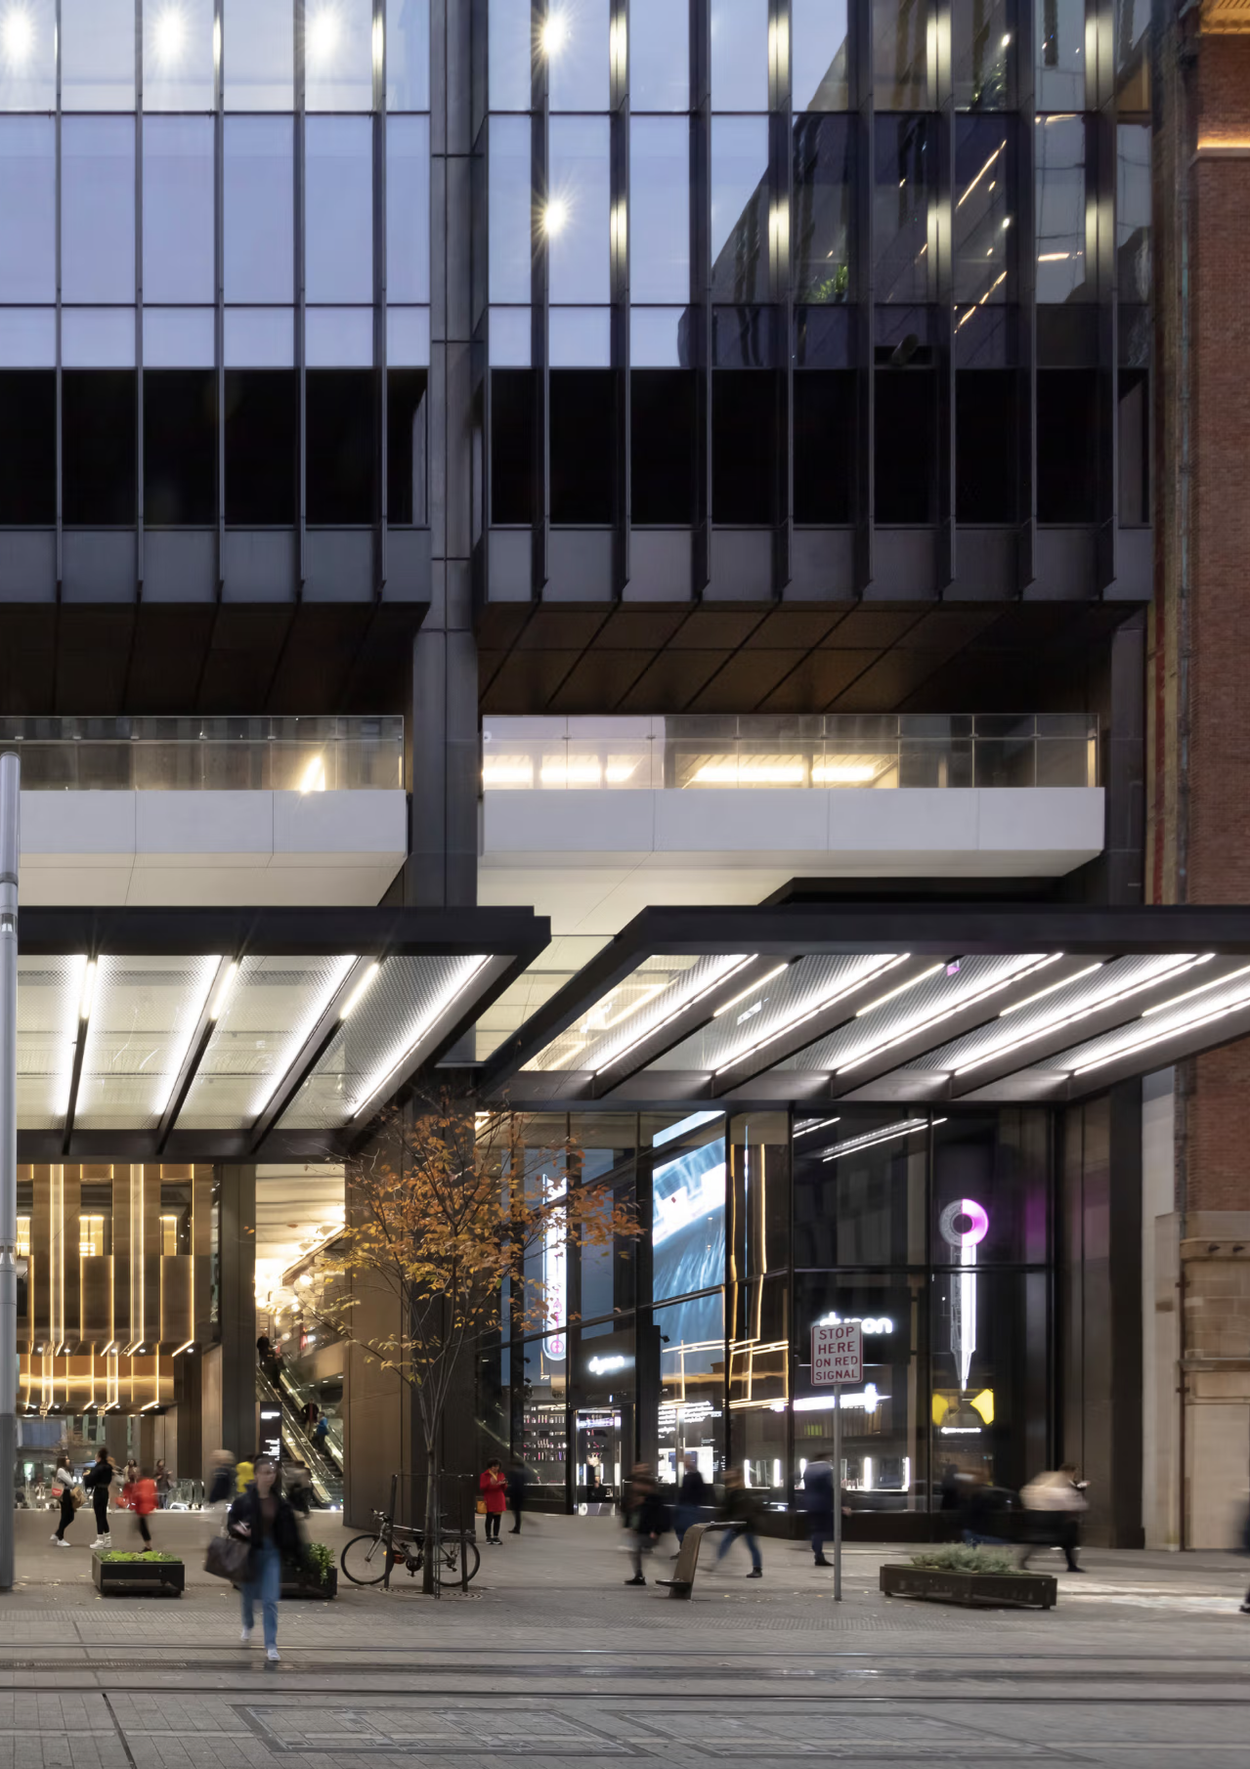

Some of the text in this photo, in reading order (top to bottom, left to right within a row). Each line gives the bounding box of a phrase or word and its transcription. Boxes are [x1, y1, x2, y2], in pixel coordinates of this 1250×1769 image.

[819, 1326, 855, 1340] STOP
[818, 1341, 855, 1355] HERE
[815, 1355, 858, 1368] ON RED
[815, 1369, 858, 1381] SIGNAL
